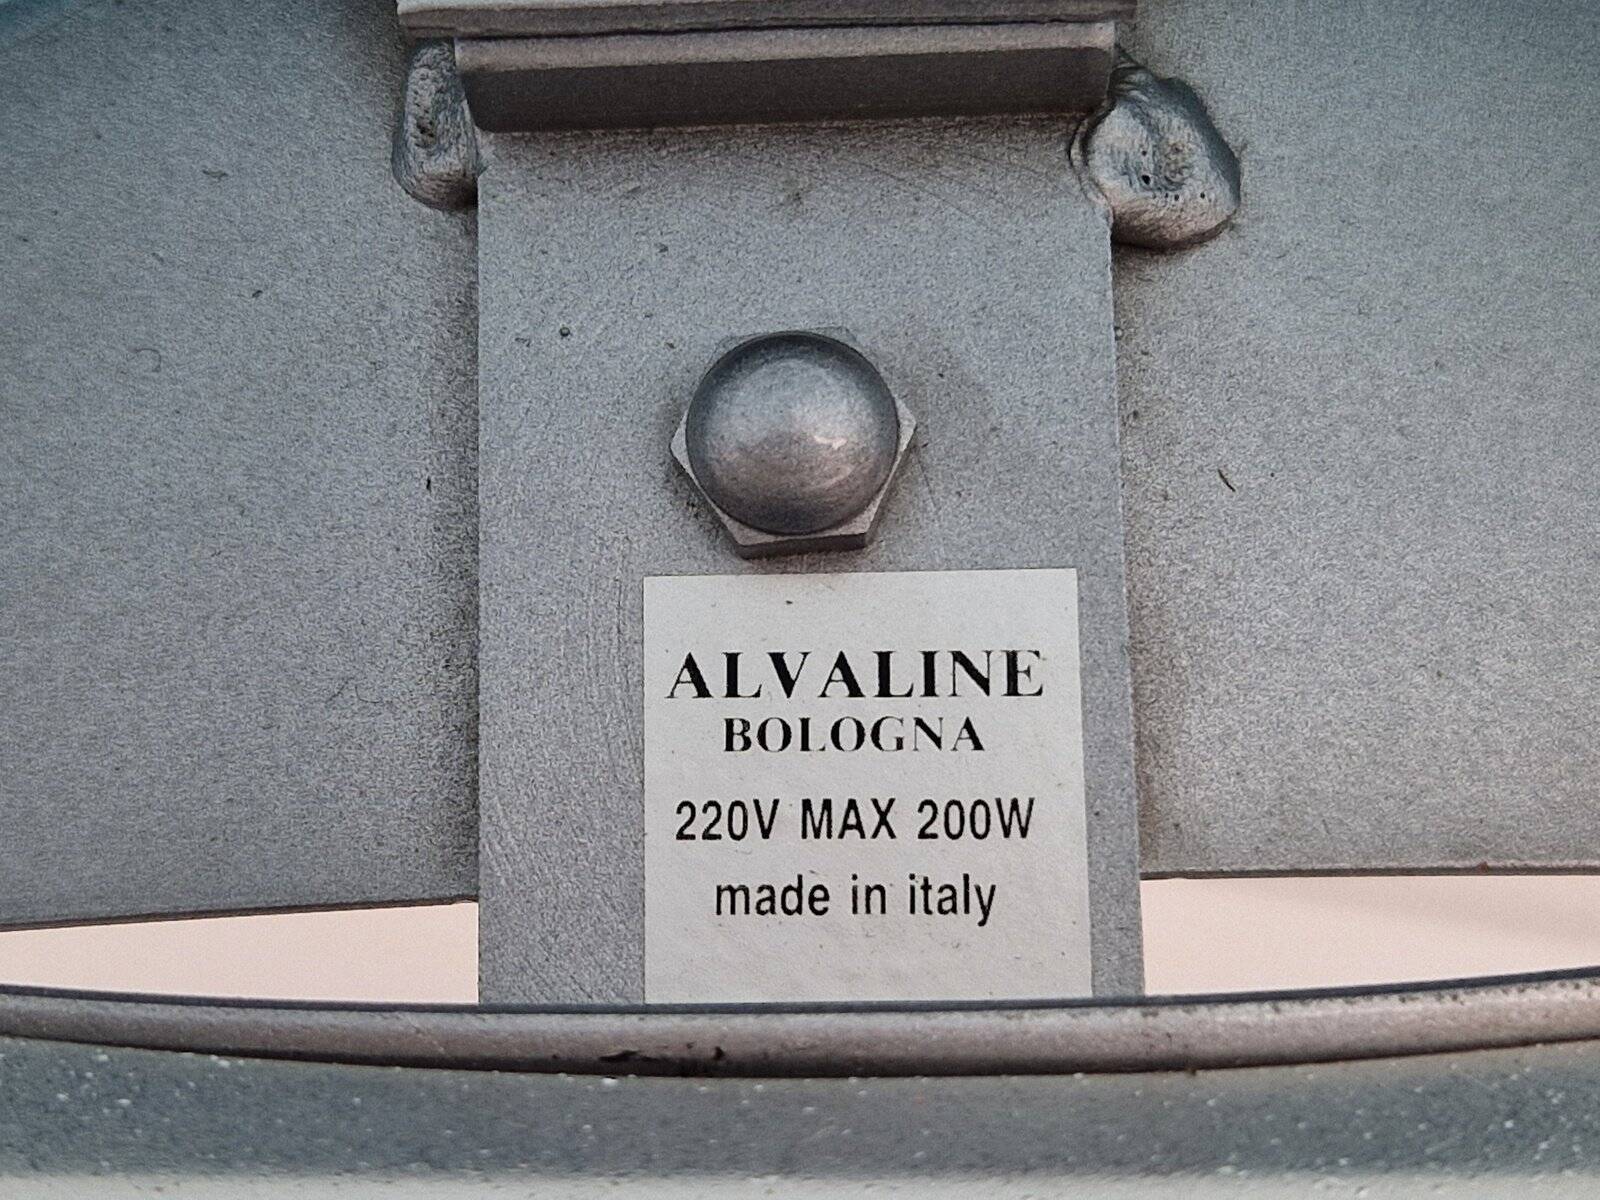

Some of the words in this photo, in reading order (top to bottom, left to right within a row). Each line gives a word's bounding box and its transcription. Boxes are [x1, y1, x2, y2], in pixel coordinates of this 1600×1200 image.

[665, 649, 1044, 699] ALVALINE
[723, 716, 985, 753] BOLOGNA
[675, 798, 780, 842] 220V
[801, 797, 897, 840] MAX
[917, 797, 1036, 841] 200W
[715, 873, 831, 917] made
[851, 873, 887, 916] in
[908, 873, 997, 928] italy
